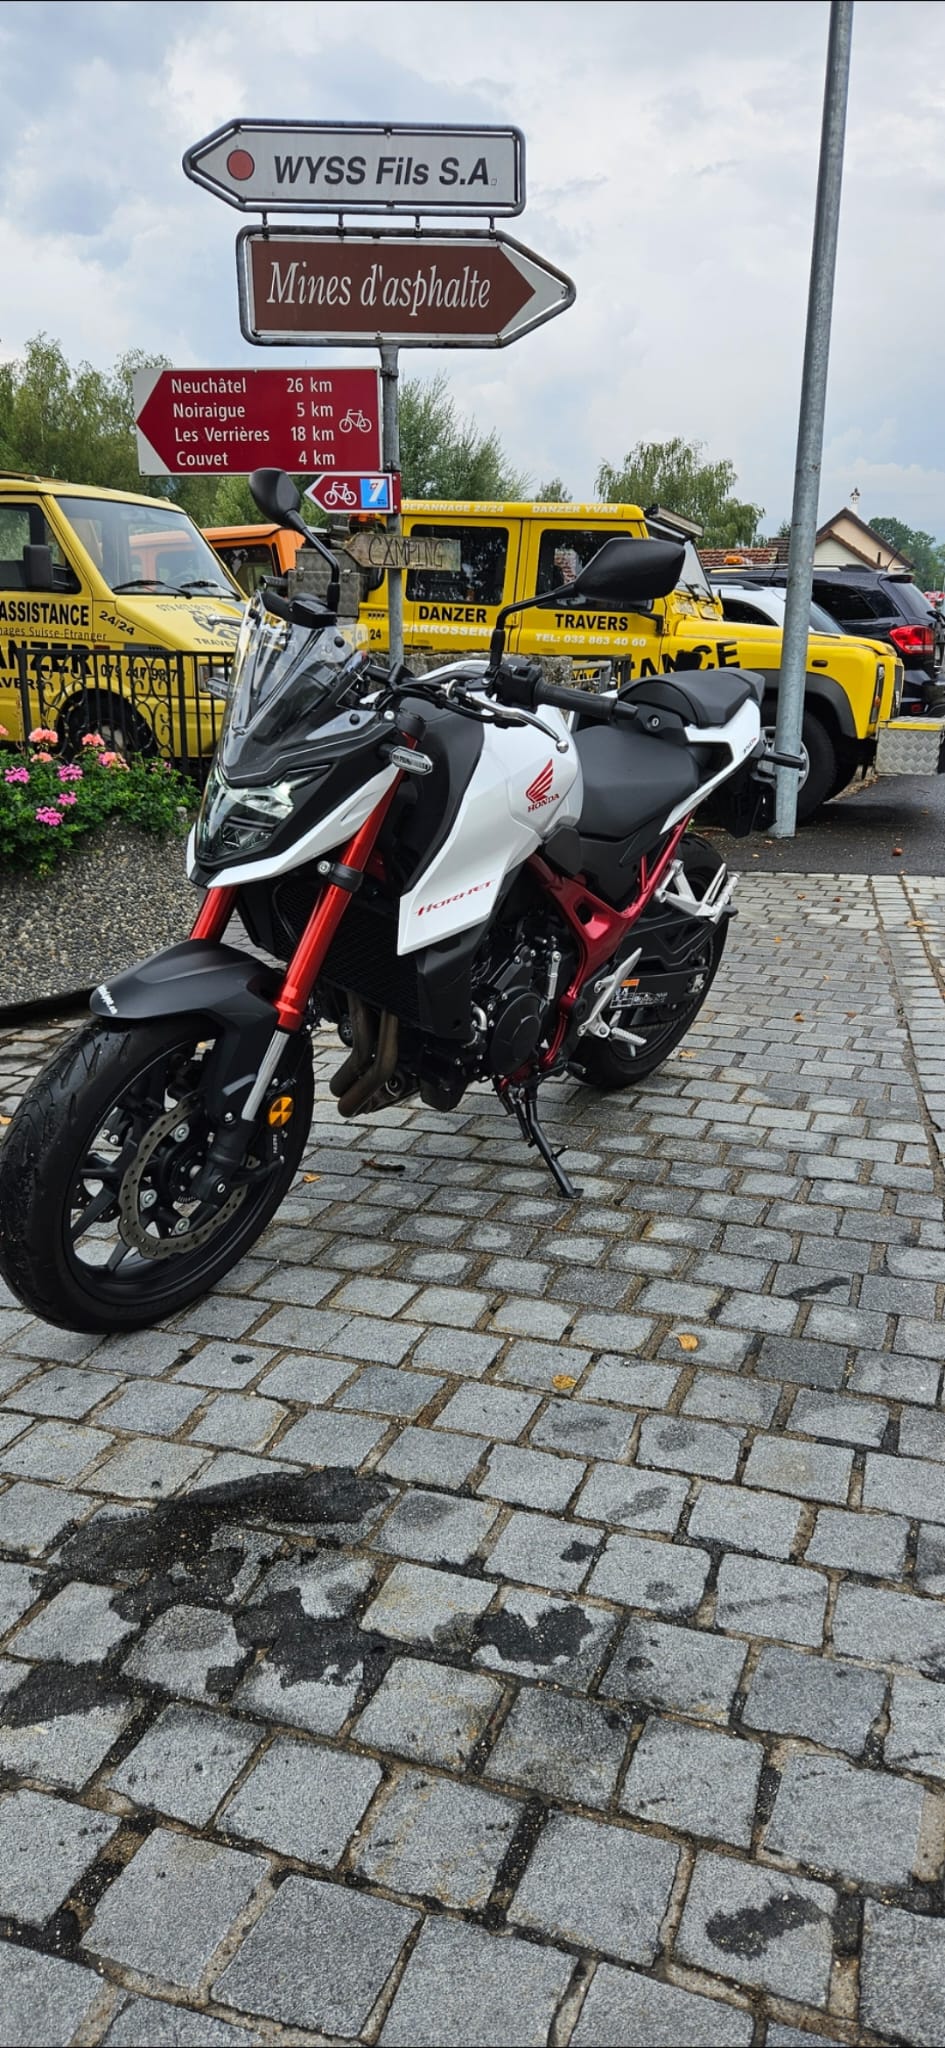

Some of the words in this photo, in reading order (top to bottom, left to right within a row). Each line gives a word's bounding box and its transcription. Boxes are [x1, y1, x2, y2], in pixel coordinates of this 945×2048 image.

[273, 155, 367, 185] WYSS
[375, 156, 430, 186] Fils
[266, 260, 352, 306] Mines
[360, 263, 491, 317] d'asphalte
[171, 377, 247, 394] Neuchâtel
[286, 377, 304, 393] 26
[310, 376, 333, 393] km
[172, 402, 246, 422] Noiraigue
[296, 402, 305, 417] 5
[311, 401, 334, 417] km
[175, 427, 199, 442] Les
[204, 426, 270, 442] Verrières
[290, 426, 306, 442] 18
[312, 425, 335, 441] km
[176, 451, 229, 466] Couvet
[298, 450, 307, 465] 4
[313, 449, 336, 465] km
[369, 478, 386, 503] 7
[368, 533, 443, 569] CAMPING
[0, 600, 89, 626] ASSISTANCE
[98, 610, 136, 636] 24/24
[418, 605, 487, 623] DANZER
[554, 613, 629, 631] TRAVERS
[535, 633, 560, 643] TEL:
[527, 793, 560, 813] HONDA
